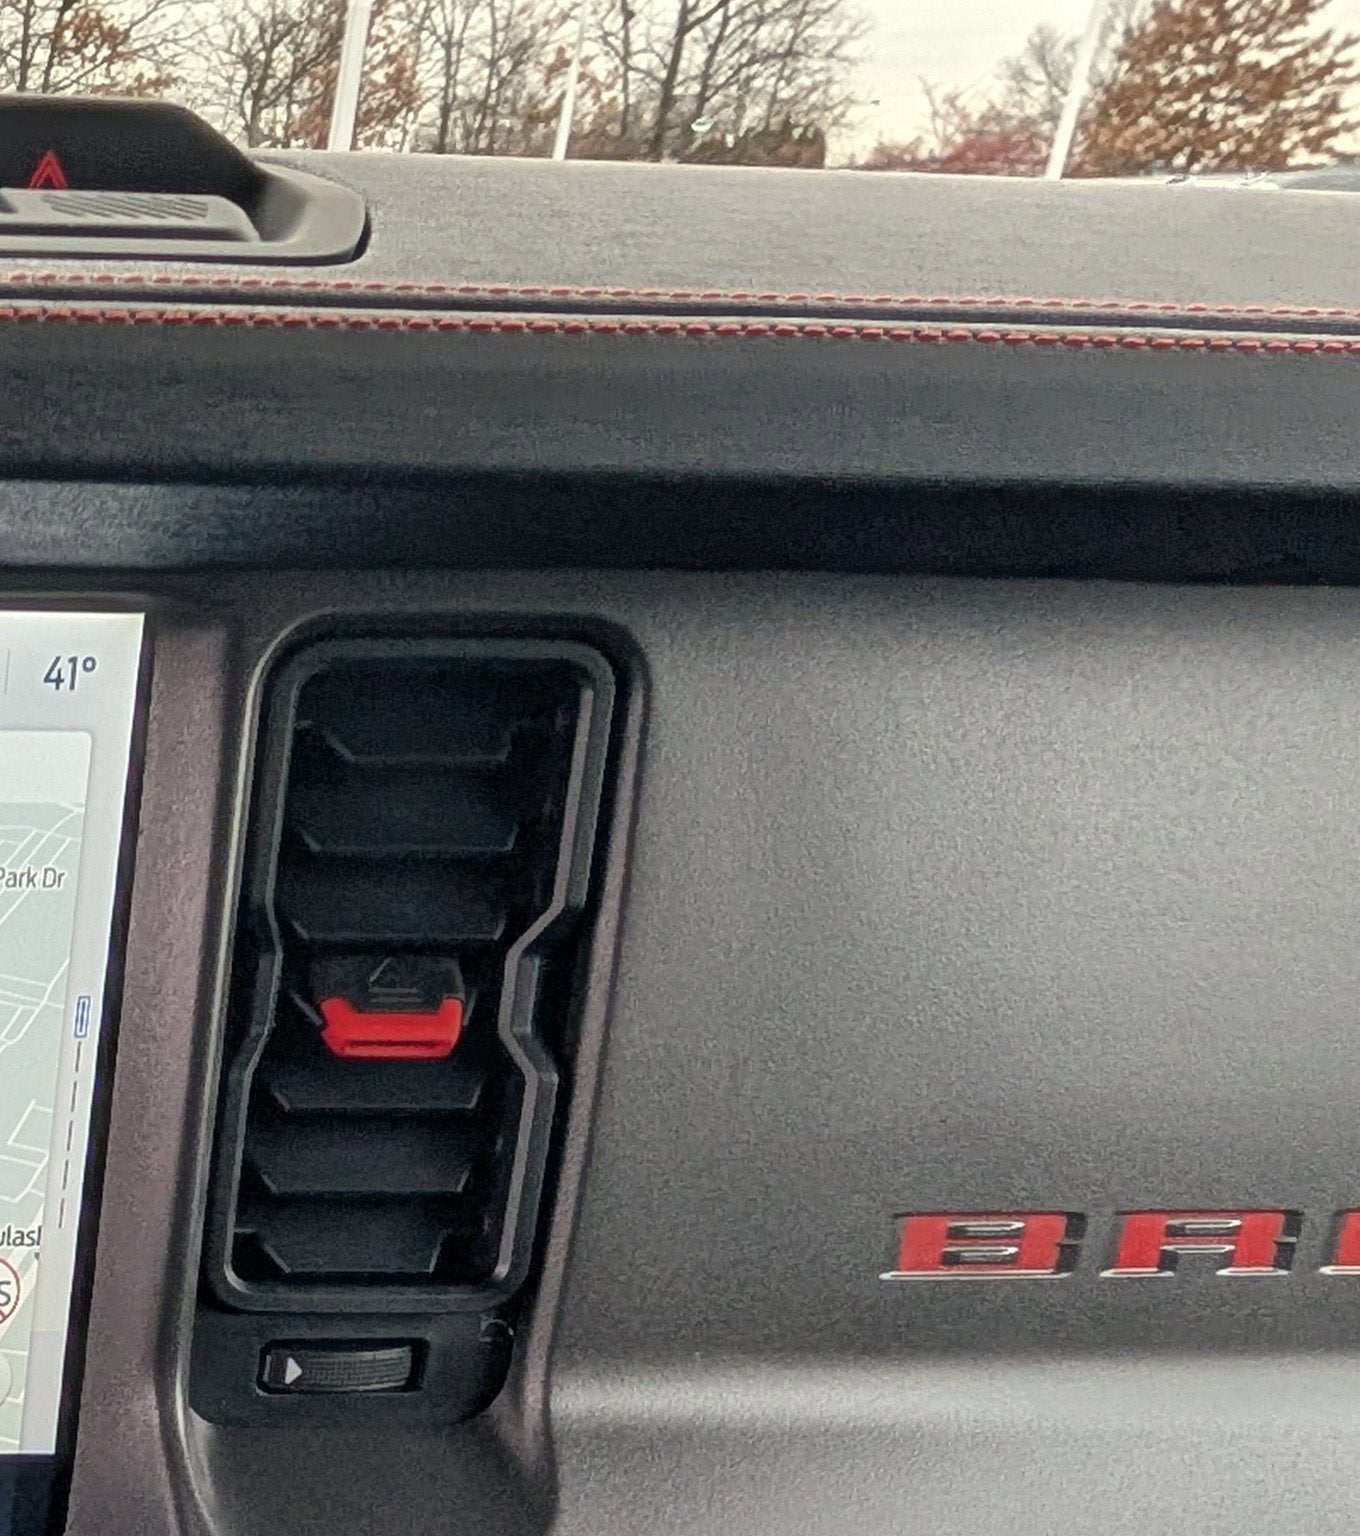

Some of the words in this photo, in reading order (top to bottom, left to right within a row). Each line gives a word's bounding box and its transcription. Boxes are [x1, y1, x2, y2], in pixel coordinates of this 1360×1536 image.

[42, 655, 98, 692] 41°
[41, 866, 67, 891] Dr
[880, 1207, 1360, 1282] BR
